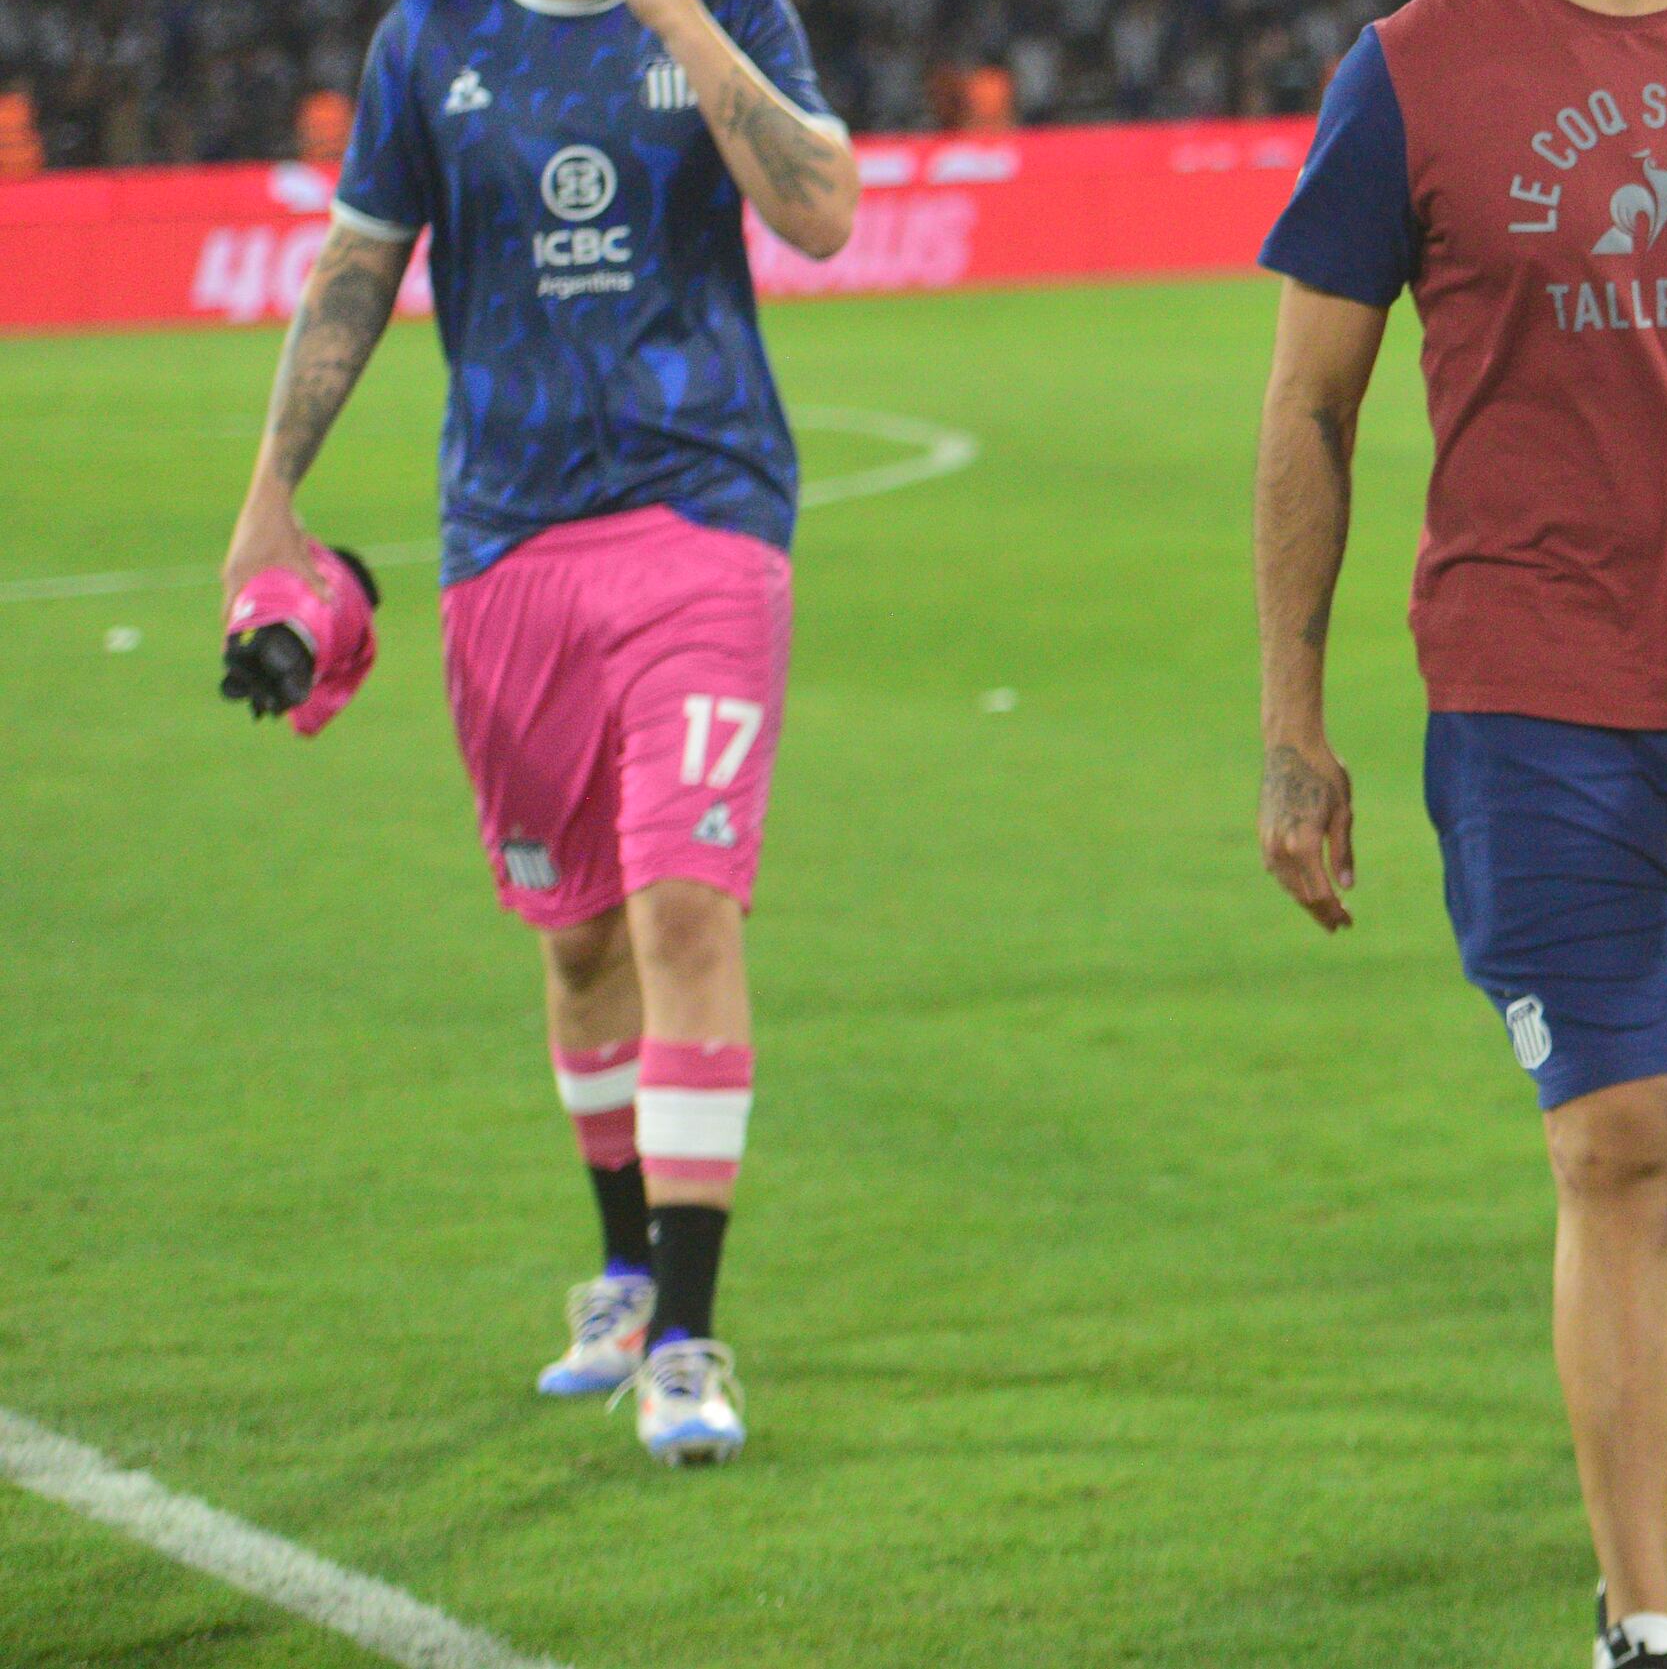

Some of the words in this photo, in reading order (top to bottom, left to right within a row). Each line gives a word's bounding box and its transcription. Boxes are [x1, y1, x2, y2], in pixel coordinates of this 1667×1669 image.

[1530, 89, 1627, 171] COQ
[1506, 174, 1562, 233] LE
[533, 225, 632, 269] ICBC
[538, 269, 634, 301] Argentina
[680, 693, 764, 789] 17
